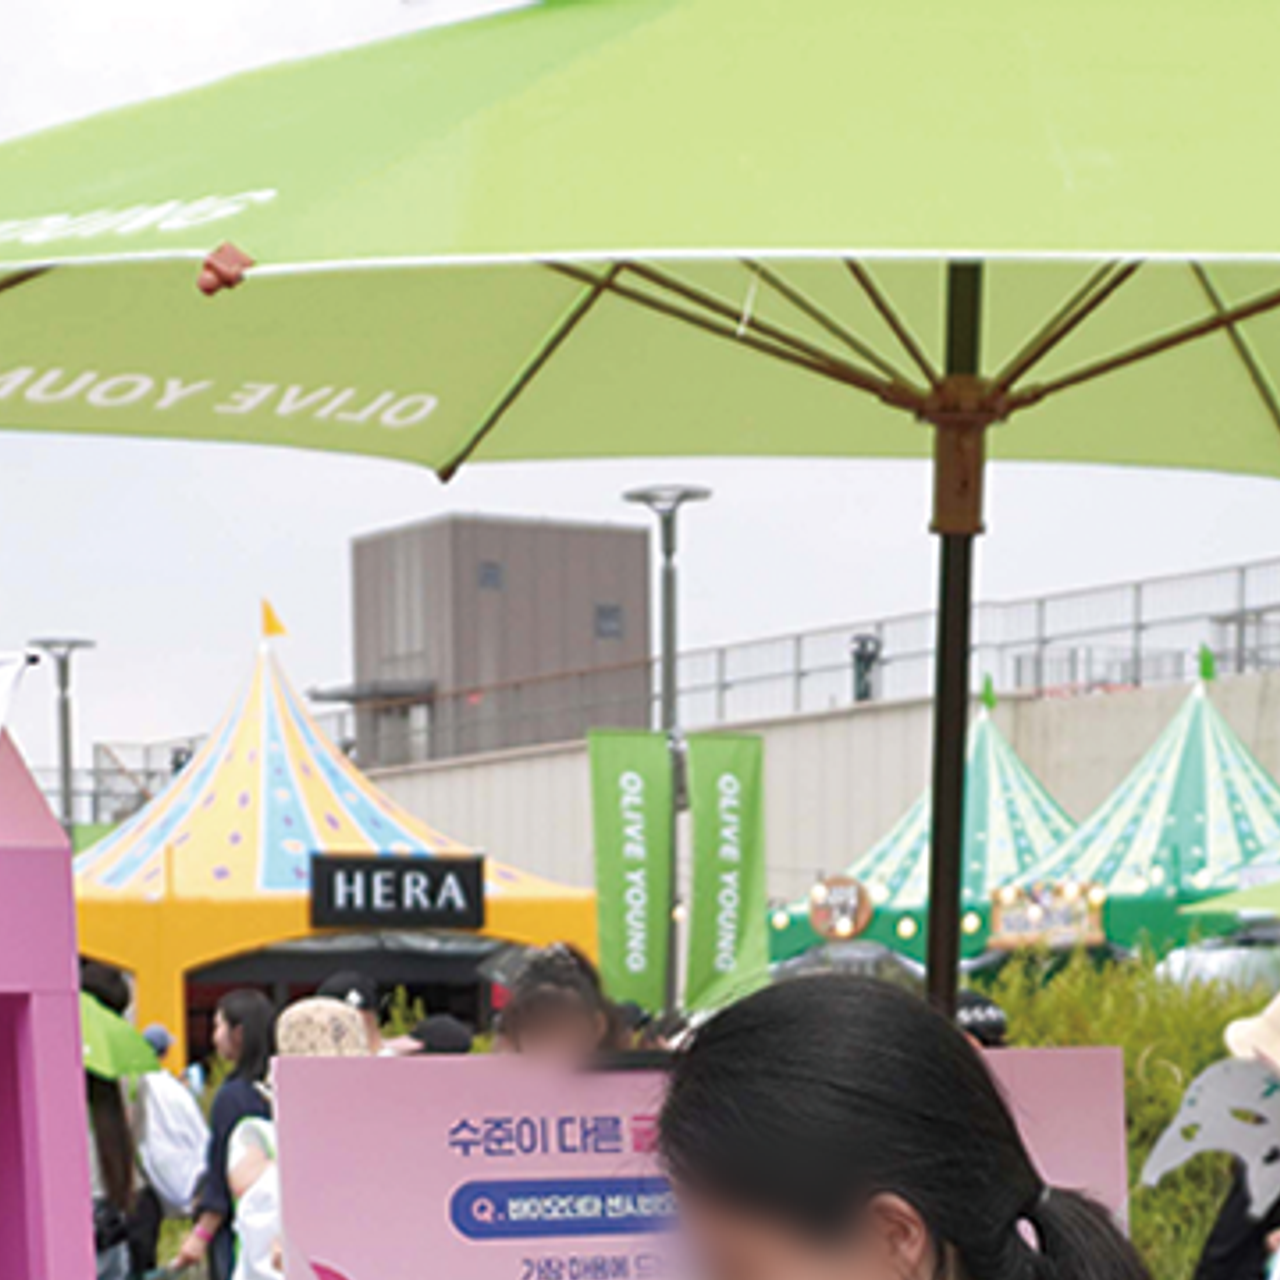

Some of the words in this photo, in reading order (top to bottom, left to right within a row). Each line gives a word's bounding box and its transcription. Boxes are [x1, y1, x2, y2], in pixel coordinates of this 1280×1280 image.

[619, 770, 646, 860] OLIVE
[717, 773, 741, 862] OLIVE
[333, 871, 468, 911] HERA
[624, 867, 647, 973] YOUNG
[715, 870, 739, 973] YOUNG
[448, 1117, 550, 1157] 수준이
[557, 1115, 624, 1154] 다른
